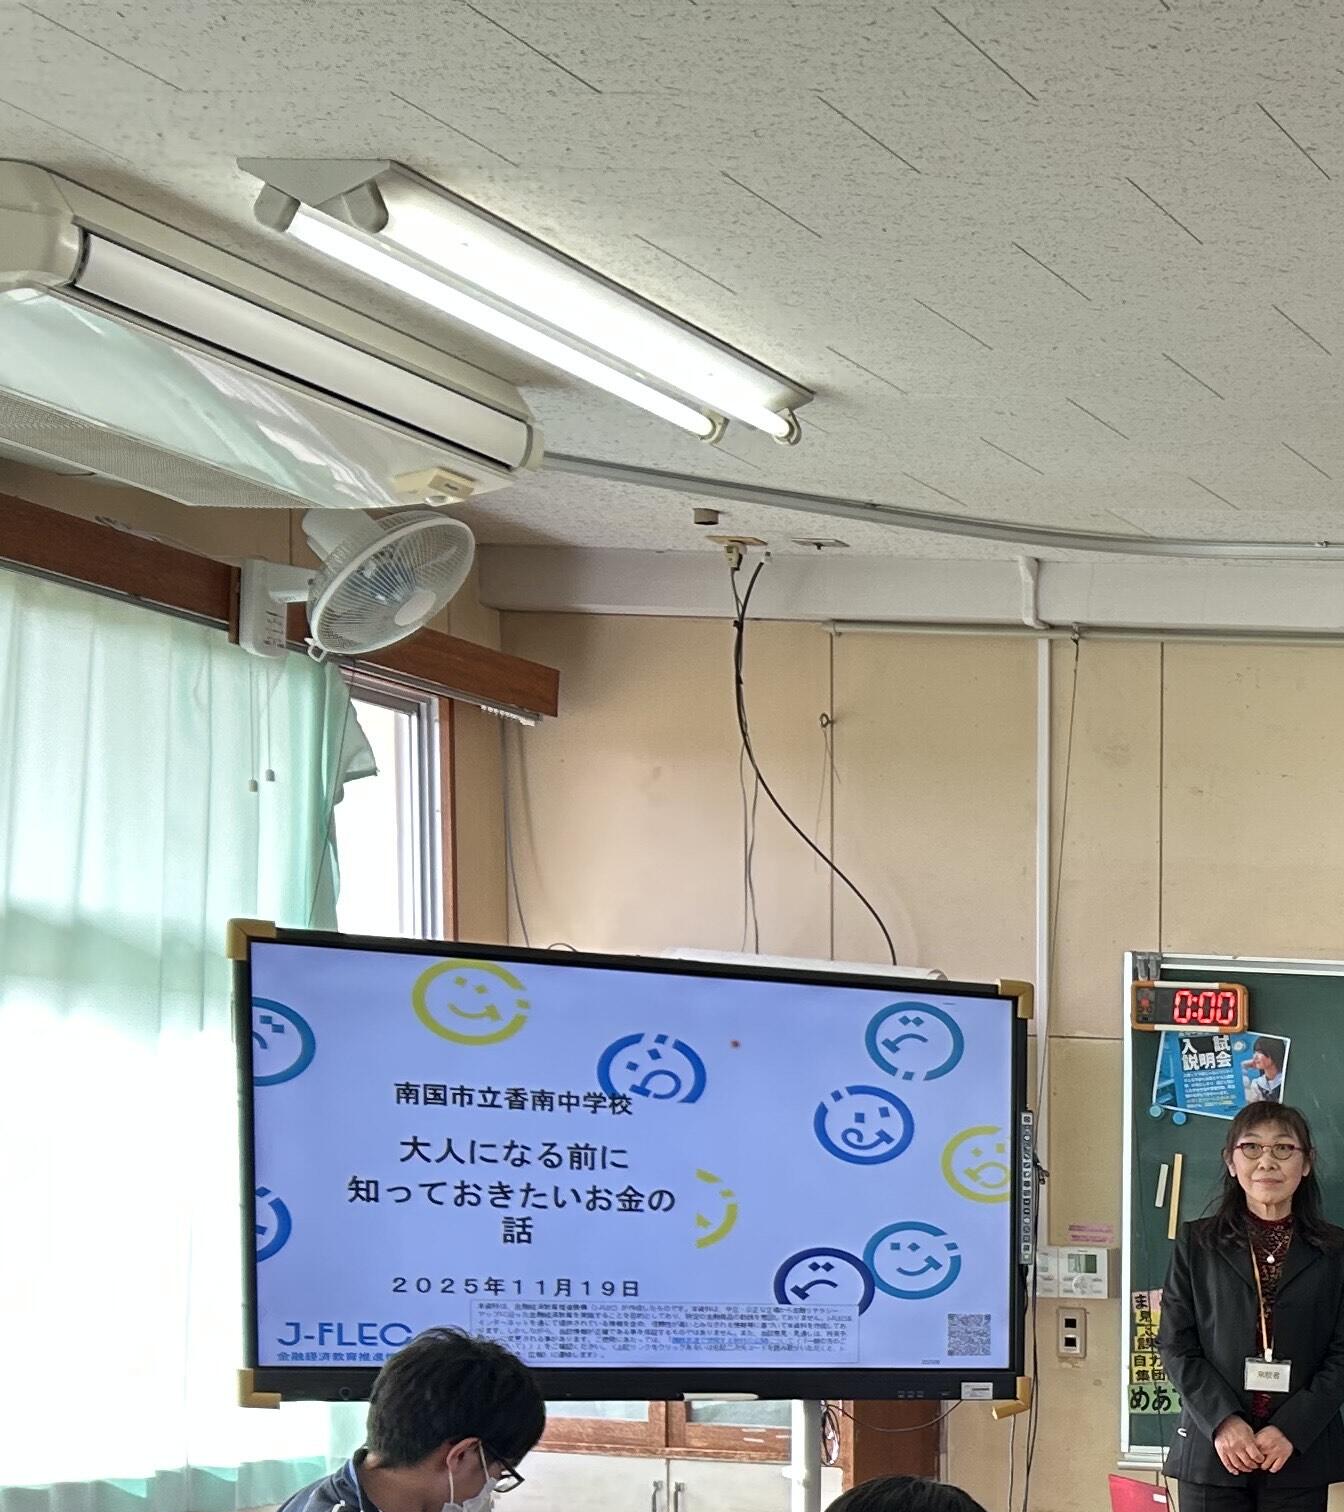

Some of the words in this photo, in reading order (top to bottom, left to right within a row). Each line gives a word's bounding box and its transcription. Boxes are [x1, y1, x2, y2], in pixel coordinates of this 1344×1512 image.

[1173, 989, 1238, 1025] 0:00
[1181, 1051, 1232, 1071] 説明会
[393, 1081, 634, 1116] 南国市立香南中学校
[399, 1135, 630, 1171] 大人になる前に
[347, 1175, 676, 1213] 知っておきたいお金の
[501, 1215, 534, 1245] 話
[391, 1276, 640, 1297] 2025年11月19日
[276, 1321, 413, 1347] J-FLEC
